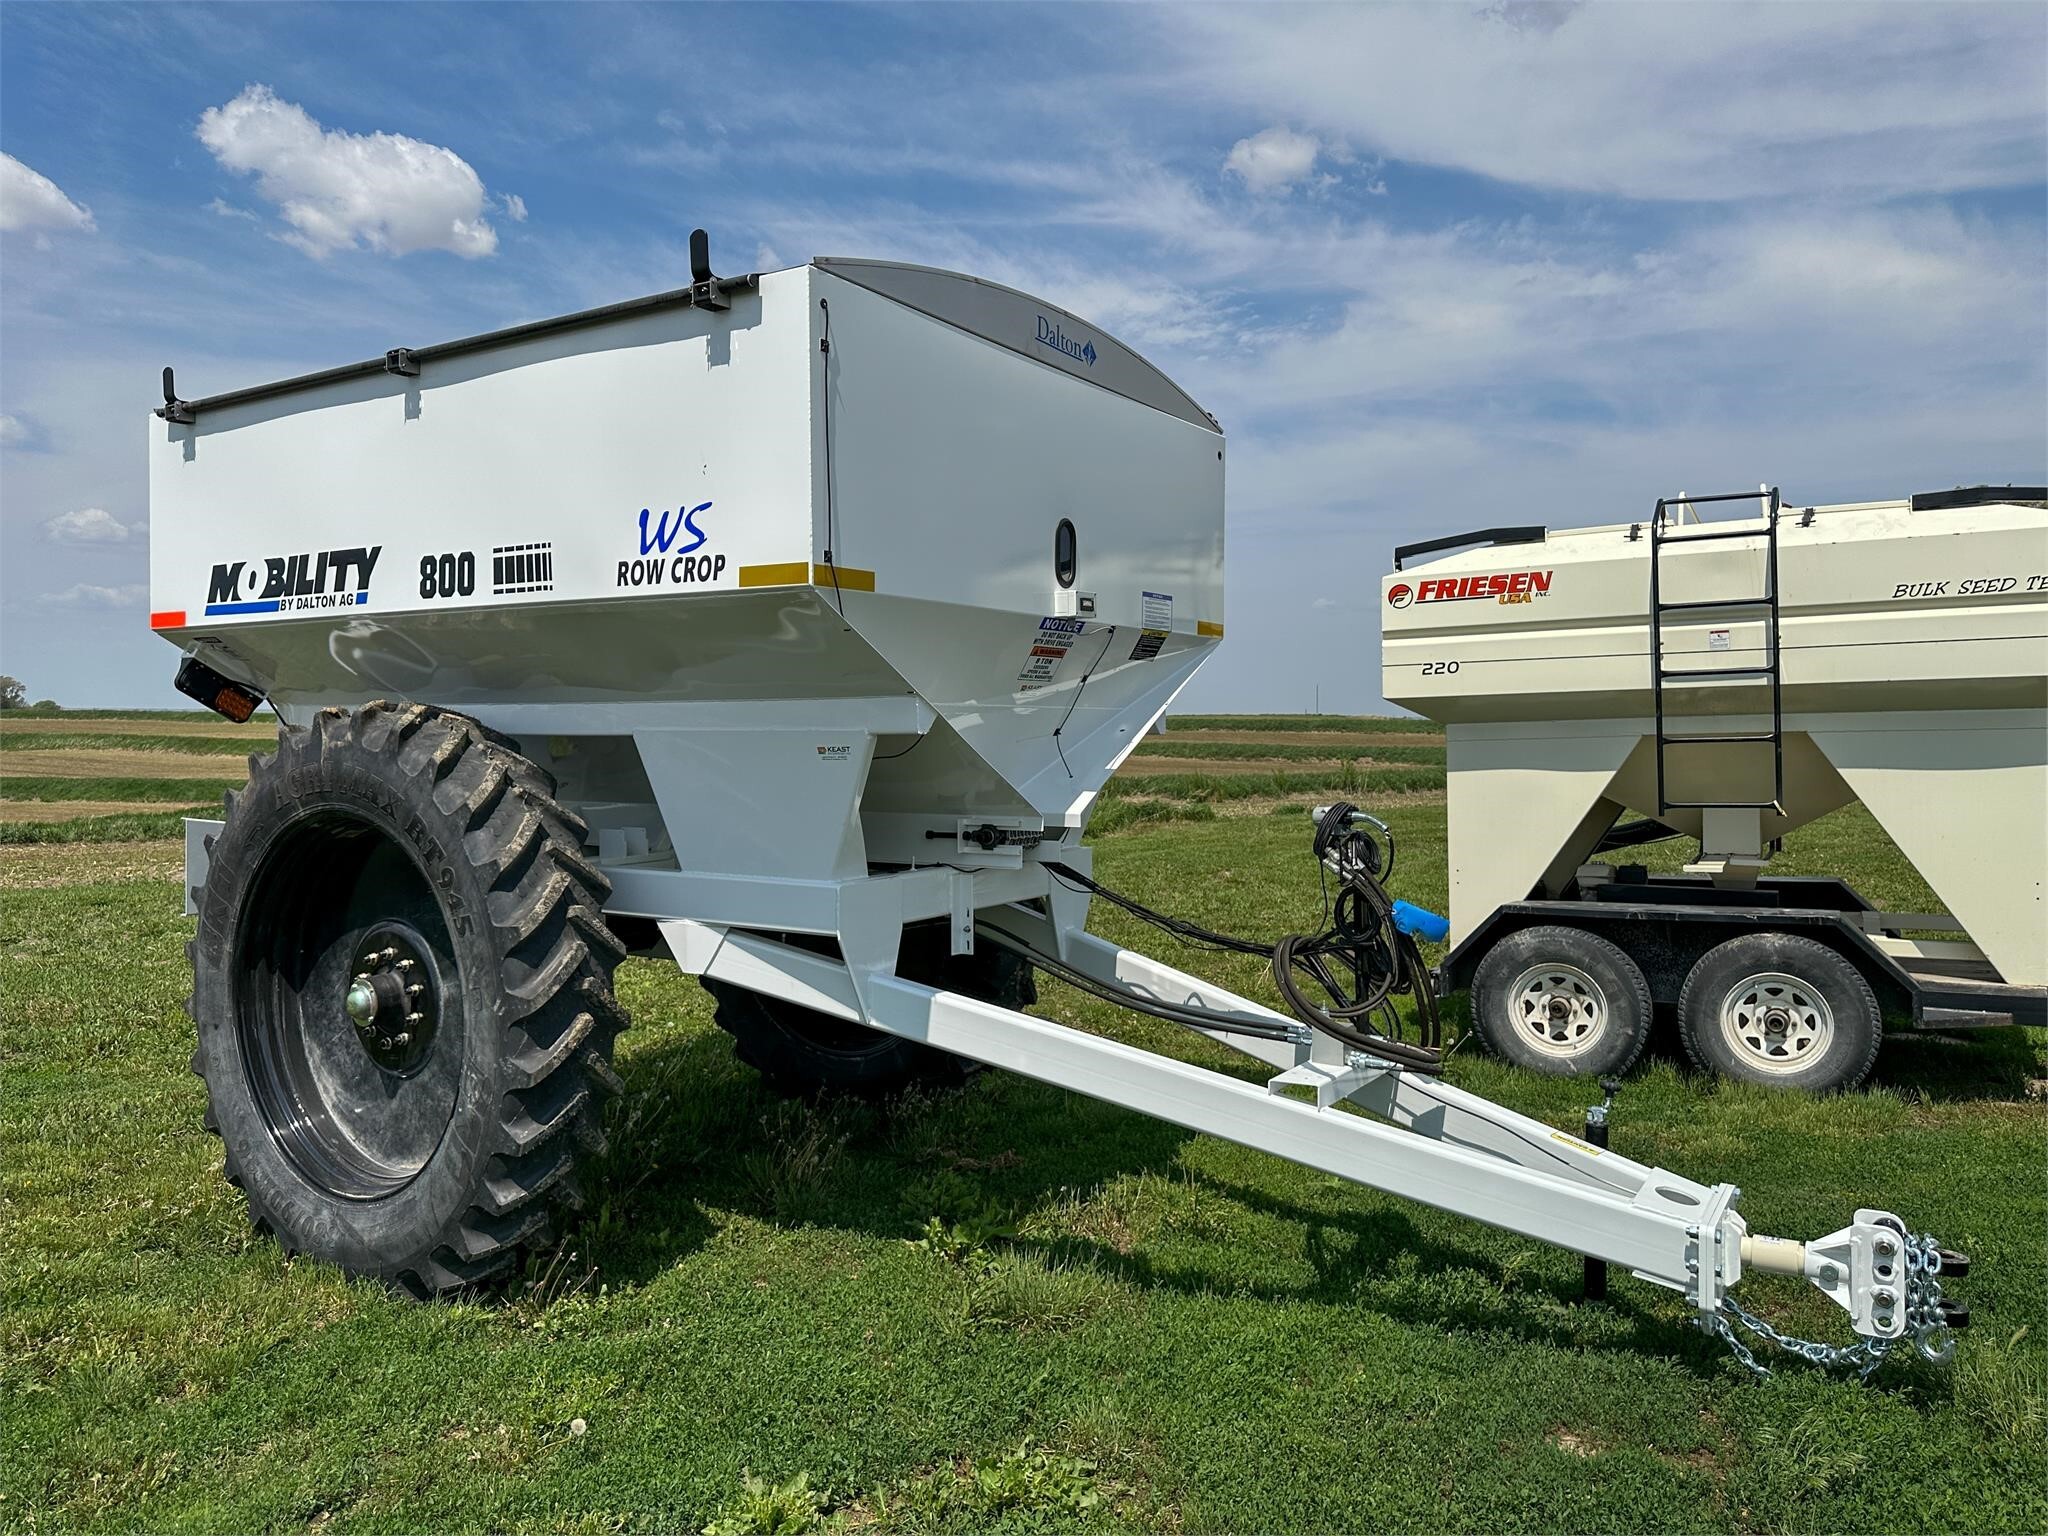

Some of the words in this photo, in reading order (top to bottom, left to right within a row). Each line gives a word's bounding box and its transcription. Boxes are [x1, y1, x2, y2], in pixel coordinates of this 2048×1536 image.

[1036, 315, 1083, 358] Dalton
[638, 501, 713, 556] WS
[207, 545, 383, 604] MOBILITY
[419, 551, 476, 599] 800
[617, 558, 666, 587] ROW
[671, 554, 726, 584] CROP
[1416, 570, 1553, 601] FRIESEN
[280, 598, 294, 611] BY
[296, 595, 337, 610] DALTON
[339, 593, 354, 606] AG
[1498, 592, 1532, 605] USA
[1892, 580, 1950, 598] BULK
[1957, 577, 2018, 595] SEED
[1421, 661, 1460, 675] 220
